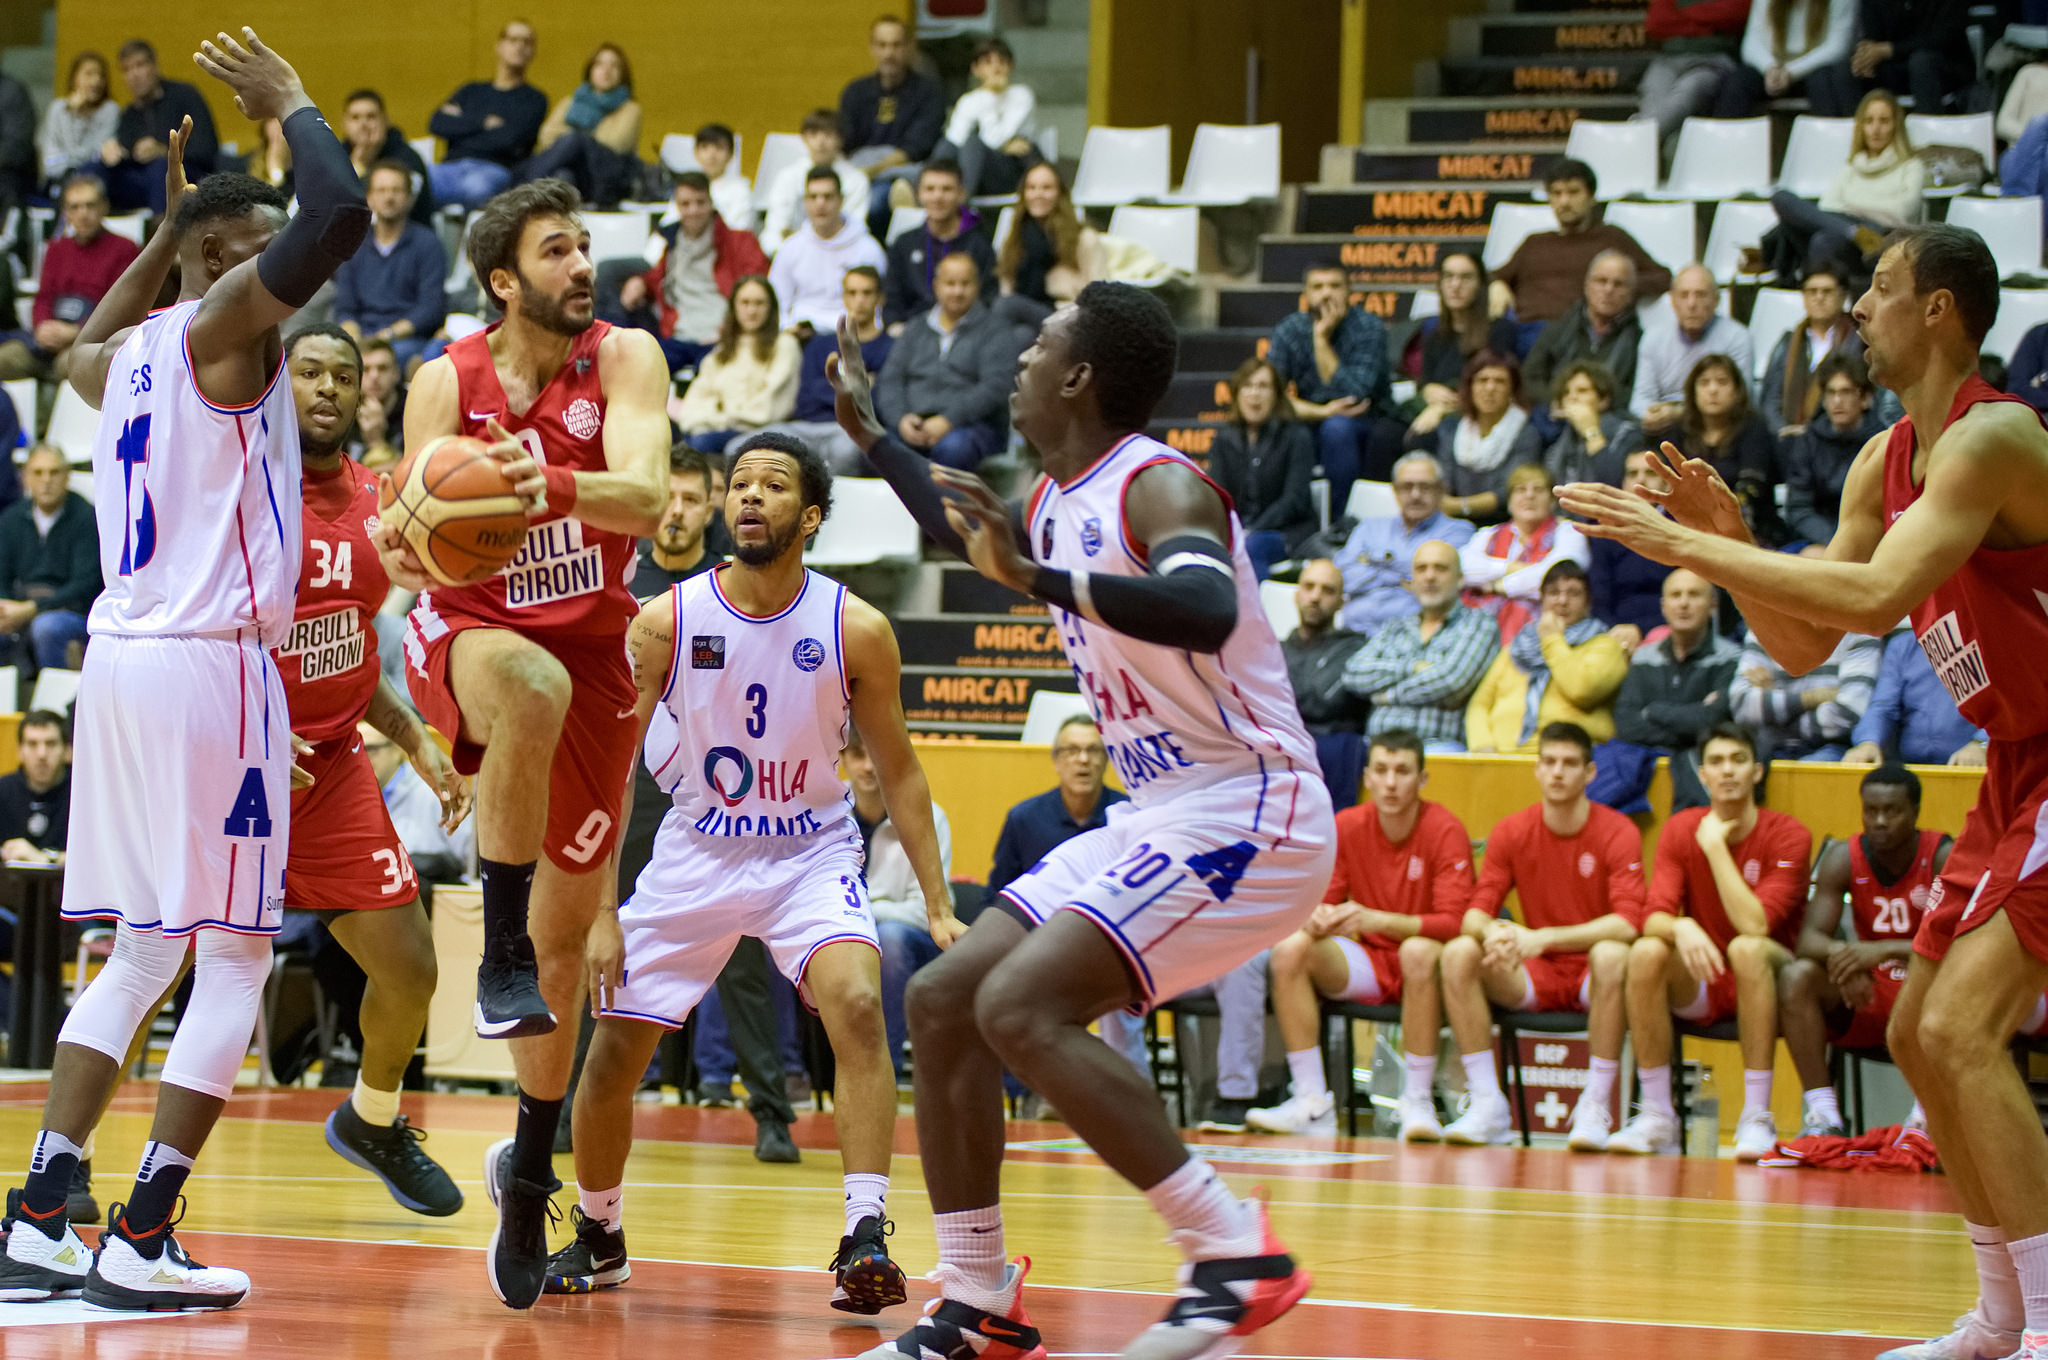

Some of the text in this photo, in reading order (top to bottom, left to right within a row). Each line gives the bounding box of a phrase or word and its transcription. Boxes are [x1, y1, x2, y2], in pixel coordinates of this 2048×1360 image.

[1485, 109, 1580, 133] MIRCAT
[1438, 154, 1534, 179] MIRCAT
[1373, 191, 1486, 218] MIRCAT
[1341, 243, 1439, 267] MIRCAT
[309, 539, 352, 590] 34
[508, 548, 598, 605] GIRONÍ
[975, 623, 1065, 651] MIRCA
[302, 633, 363, 679] GIRONÍ
[693, 651, 713, 660] LEB
[693, 660, 720, 668] PLATA
[923, 677, 1031, 704] MIRCAT
[745, 682, 768, 739] 3
[563, 809, 612, 864] 9
[372, 842, 417, 895] 34
[840, 875, 861, 909] 3
[1872, 895, 1911, 934] 20
